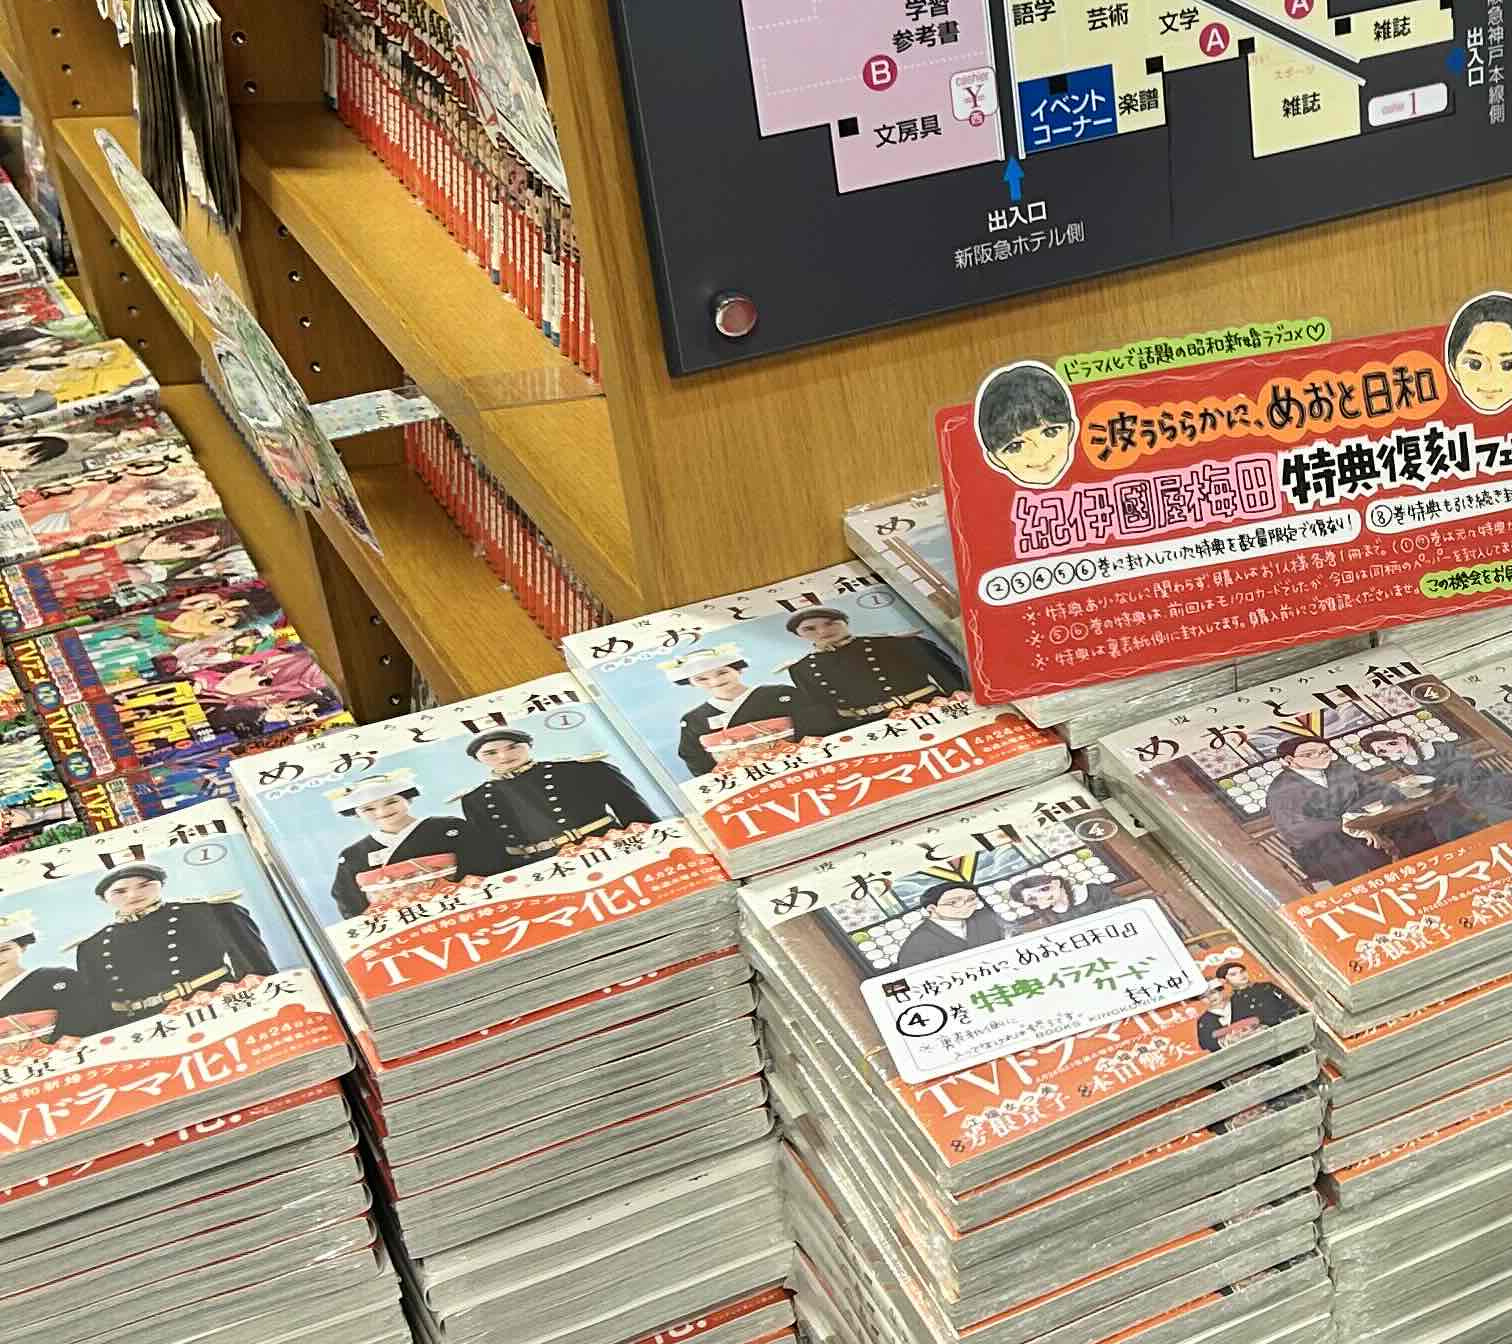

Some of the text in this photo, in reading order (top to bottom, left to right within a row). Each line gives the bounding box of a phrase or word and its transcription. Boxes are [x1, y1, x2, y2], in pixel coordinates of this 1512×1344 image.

[1086, 2, 1131, 32] 芸術
[1158, 6, 1201, 36] 文学
[1373, 15, 1413, 43] 雑誌
[892, 20, 961, 53] 参考書
[1466, 26, 1486, 87] 出入口
[1029, 92, 1107, 121] イベント
[1118, 87, 1160, 116] 楽譜
[1282, 91, 1322, 120] 雑誌
[874, 113, 943, 148] 文房具
[1032, 116, 1114, 147] コーナー
[987, 200, 1048, 233] 出入口
[953, 220, 1086, 270] 新阪急ホテル側
[1087, 365, 1438, 462] 波うららかに、めおと日和
[1016, 458, 1278, 550] 紀伊國屋梅田
[880, 699, 973, 741] 本田響
[723, 738, 984, 844] TVドラマ化!
[365, 877, 651, 988] TVドラマ化!
